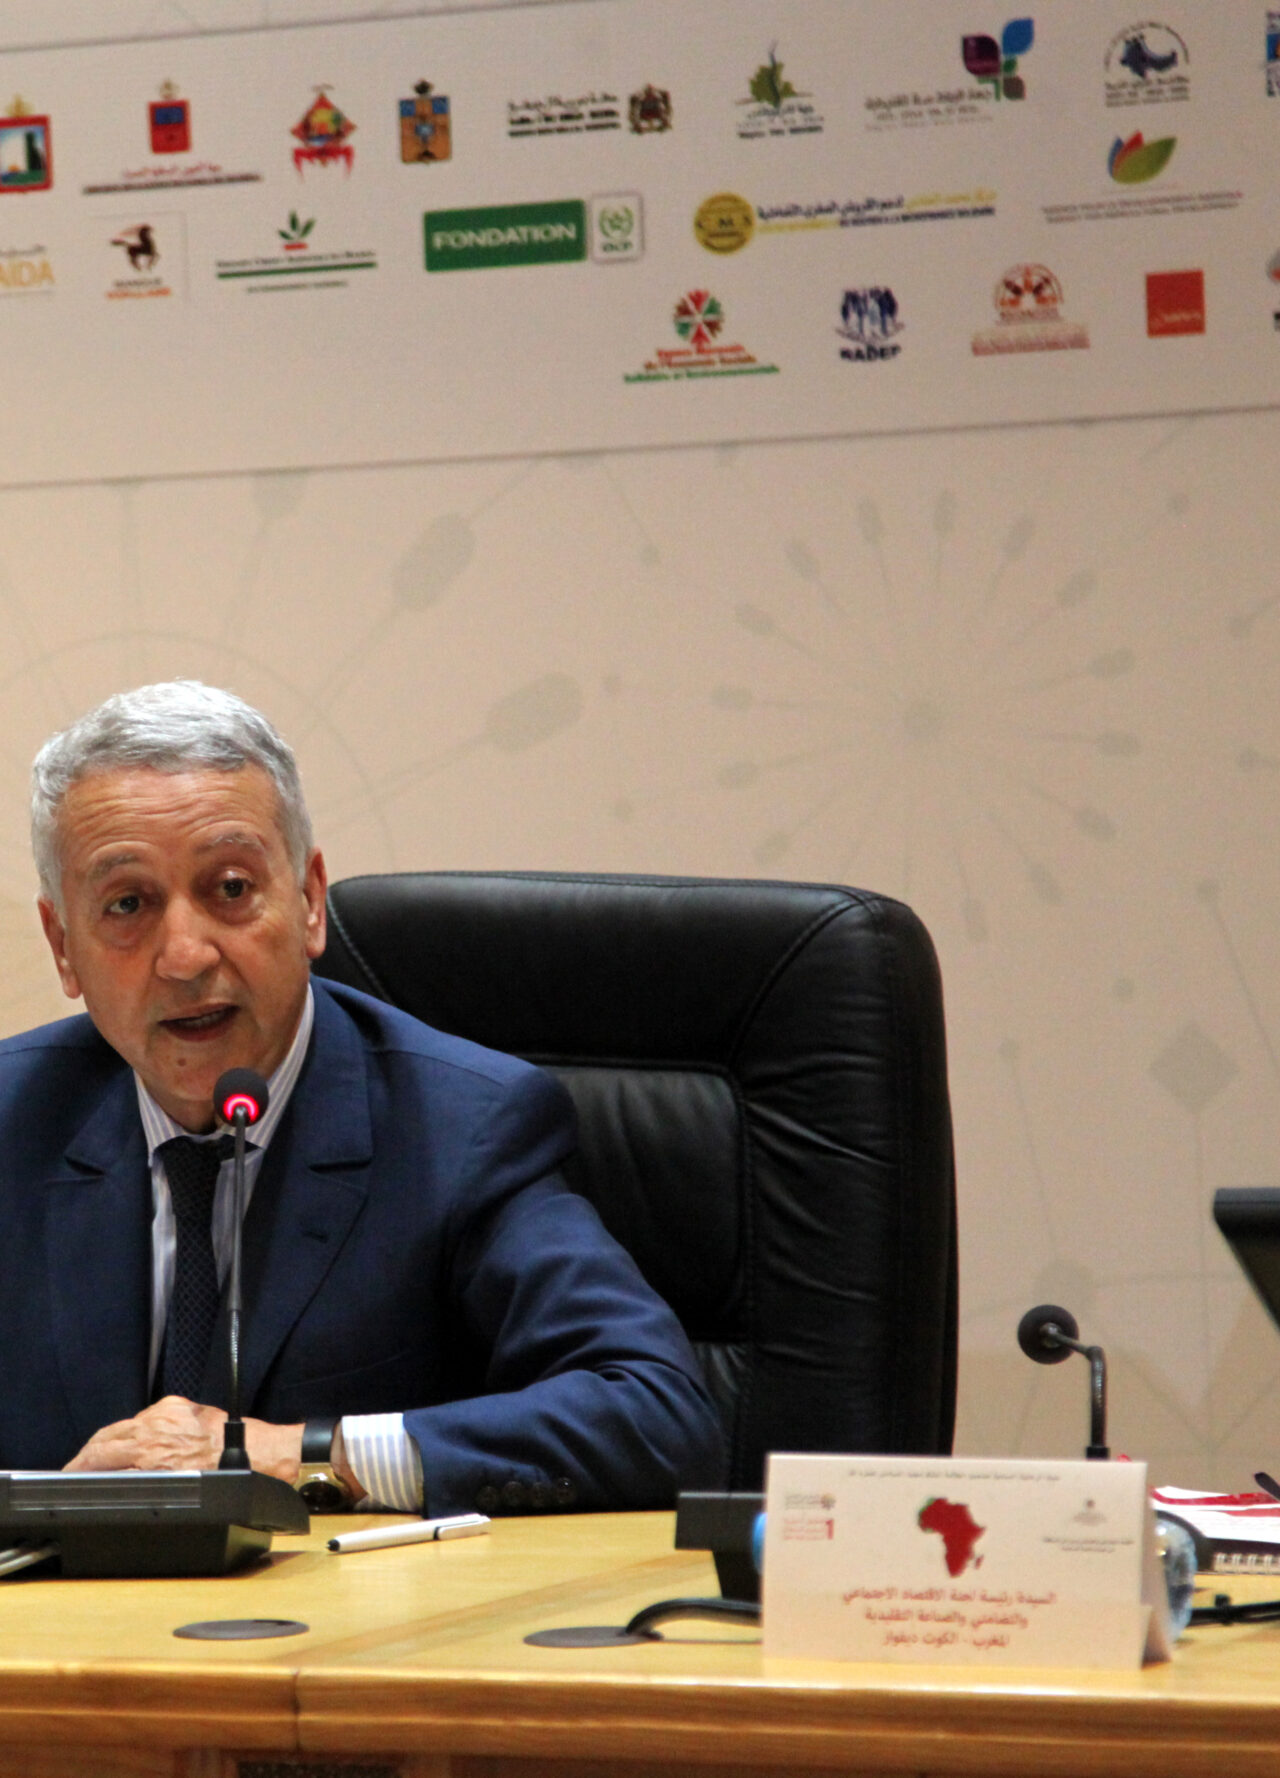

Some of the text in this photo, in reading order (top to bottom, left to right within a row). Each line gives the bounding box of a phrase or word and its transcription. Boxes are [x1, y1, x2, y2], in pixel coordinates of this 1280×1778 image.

[432, 222, 577, 250] FONDATION
[842, 1586, 898, 1605] الاجتماعي
[902, 1586, 945, 1601] الاقتصاد
[950, 1588, 976, 1602] لجنة
[865, 1607, 913, 1624] التقليدية
[917, 1608, 966, 1626] والصناعة
